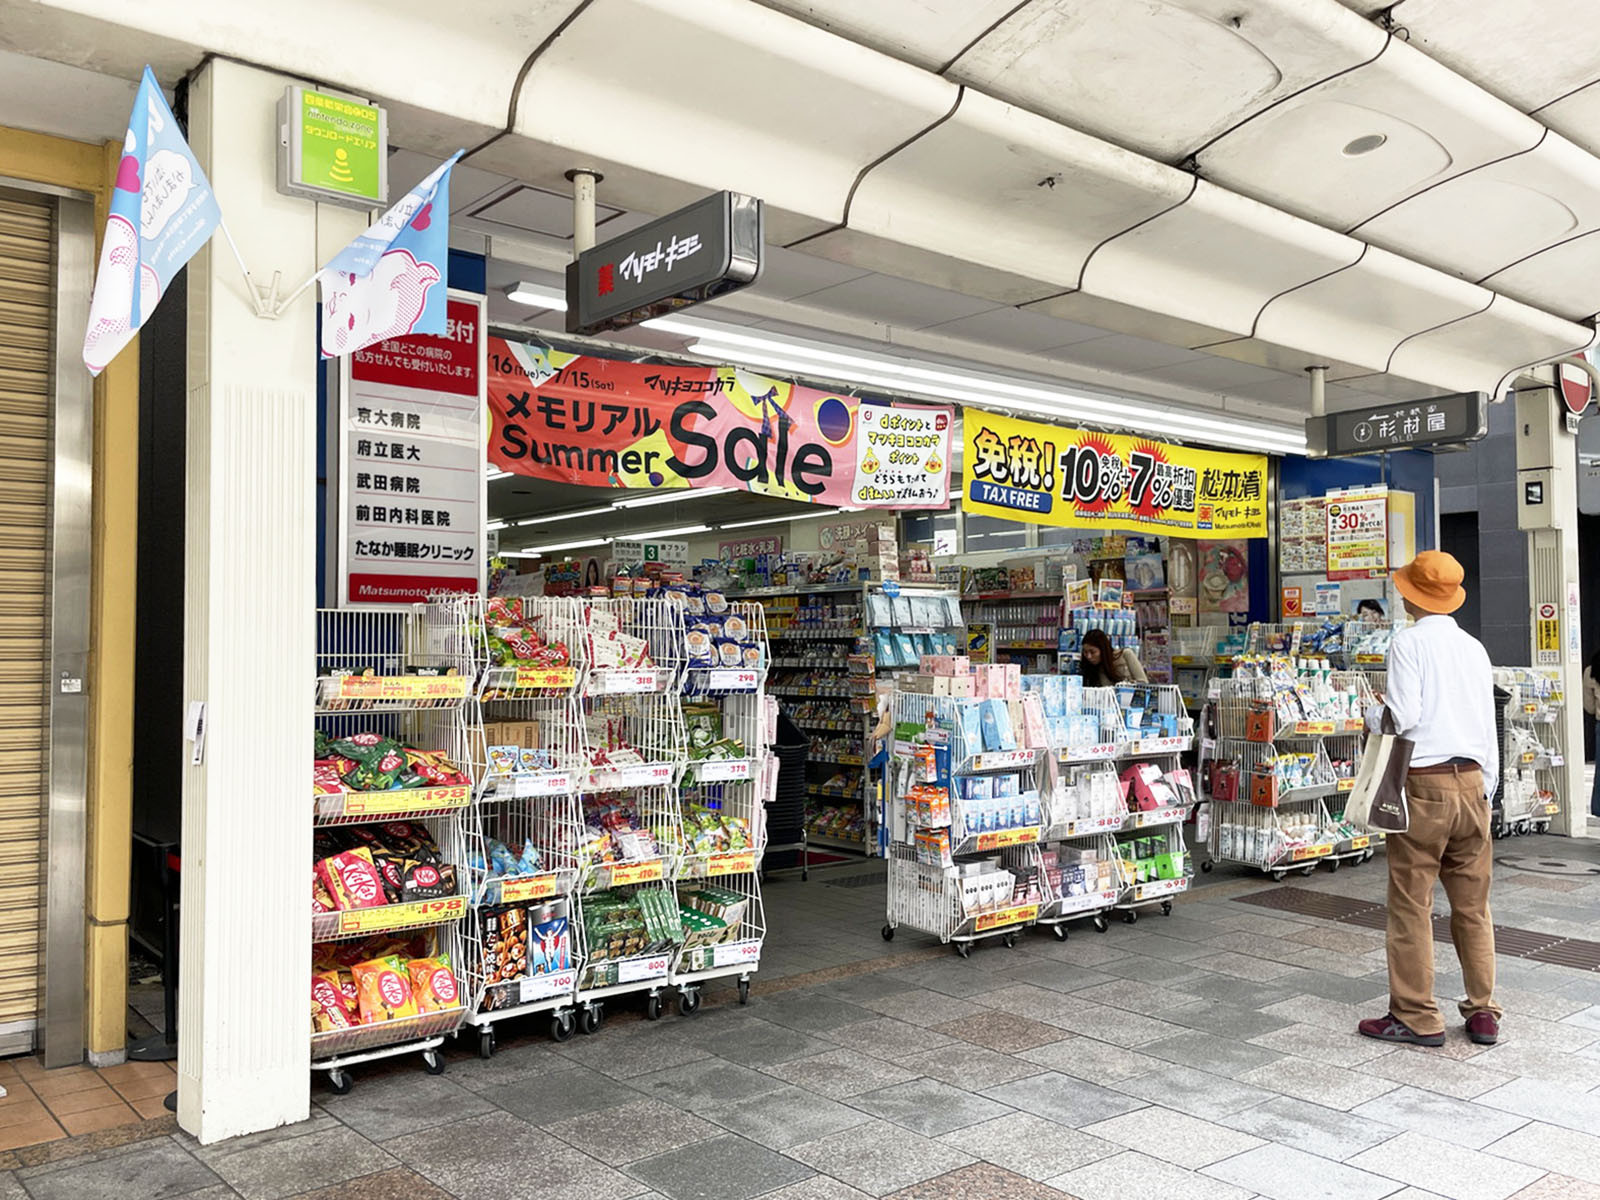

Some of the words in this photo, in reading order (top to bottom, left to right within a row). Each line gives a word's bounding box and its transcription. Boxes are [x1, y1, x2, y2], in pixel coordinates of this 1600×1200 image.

[381, 341, 452, 361] 全国どこの病院の
[644, 374, 735, 396] マツキヨココカラ
[357, 407, 421, 430] 京大病院
[505, 390, 661, 437] メモリアル
[880, 414, 931, 431] dポイントと
[500, 423, 660, 475] Summer
[665, 400, 832, 495] Sale
[867, 431, 940, 448] マツキヨココカラ
[357, 439, 420, 461] 府立医大
[888, 449, 920, 465] ポイント
[356, 473, 420, 493] 武田病院
[1200, 468, 1262, 502] 松本清
[982, 484, 1008, 504] TAX
[1009, 491, 1040, 509] FREE
[356, 505, 450, 527] 前田内科医院
[355, 540, 474, 561] たなか睡眠クリニック
[647, 546, 656, 560] 3
[359, 585, 428, 597] Matsumoto
[426, 788, 466, 801] 198
[422, 900, 462, 914] 198
